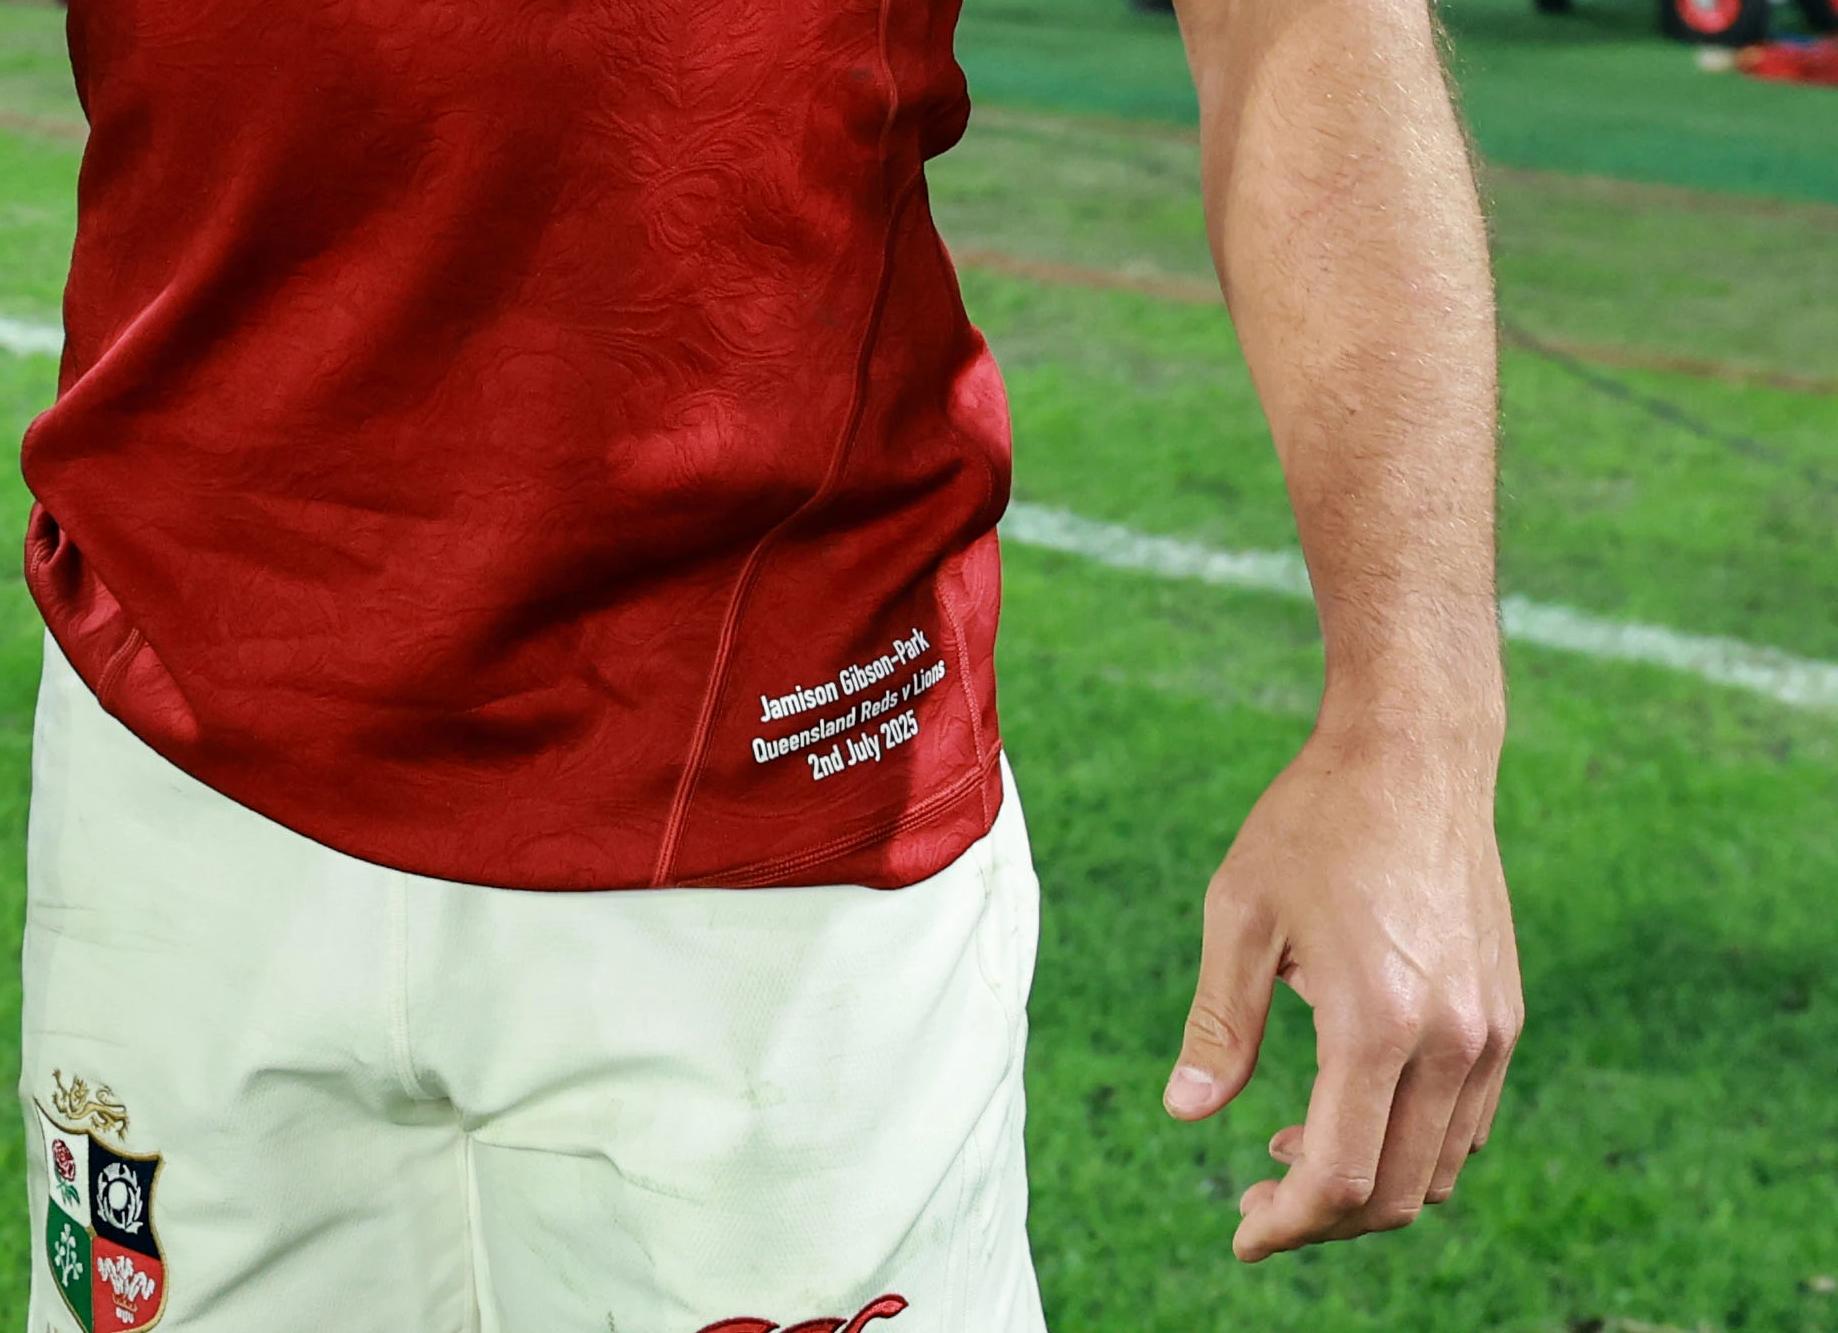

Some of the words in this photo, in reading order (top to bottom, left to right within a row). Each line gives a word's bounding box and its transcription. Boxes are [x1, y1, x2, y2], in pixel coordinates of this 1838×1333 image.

[752, 707, 856, 764] Queensland
[860, 692, 898, 723] Reds
[901, 684, 912, 702] v
[913, 659, 946, 696] Lions
[760, 684, 839, 723] Jamison
[839, 628, 930, 695] Gibson-Park
[808, 745, 845, 781] 2nd
[848, 732, 881, 766] July
[880, 709, 919, 750] 2025
